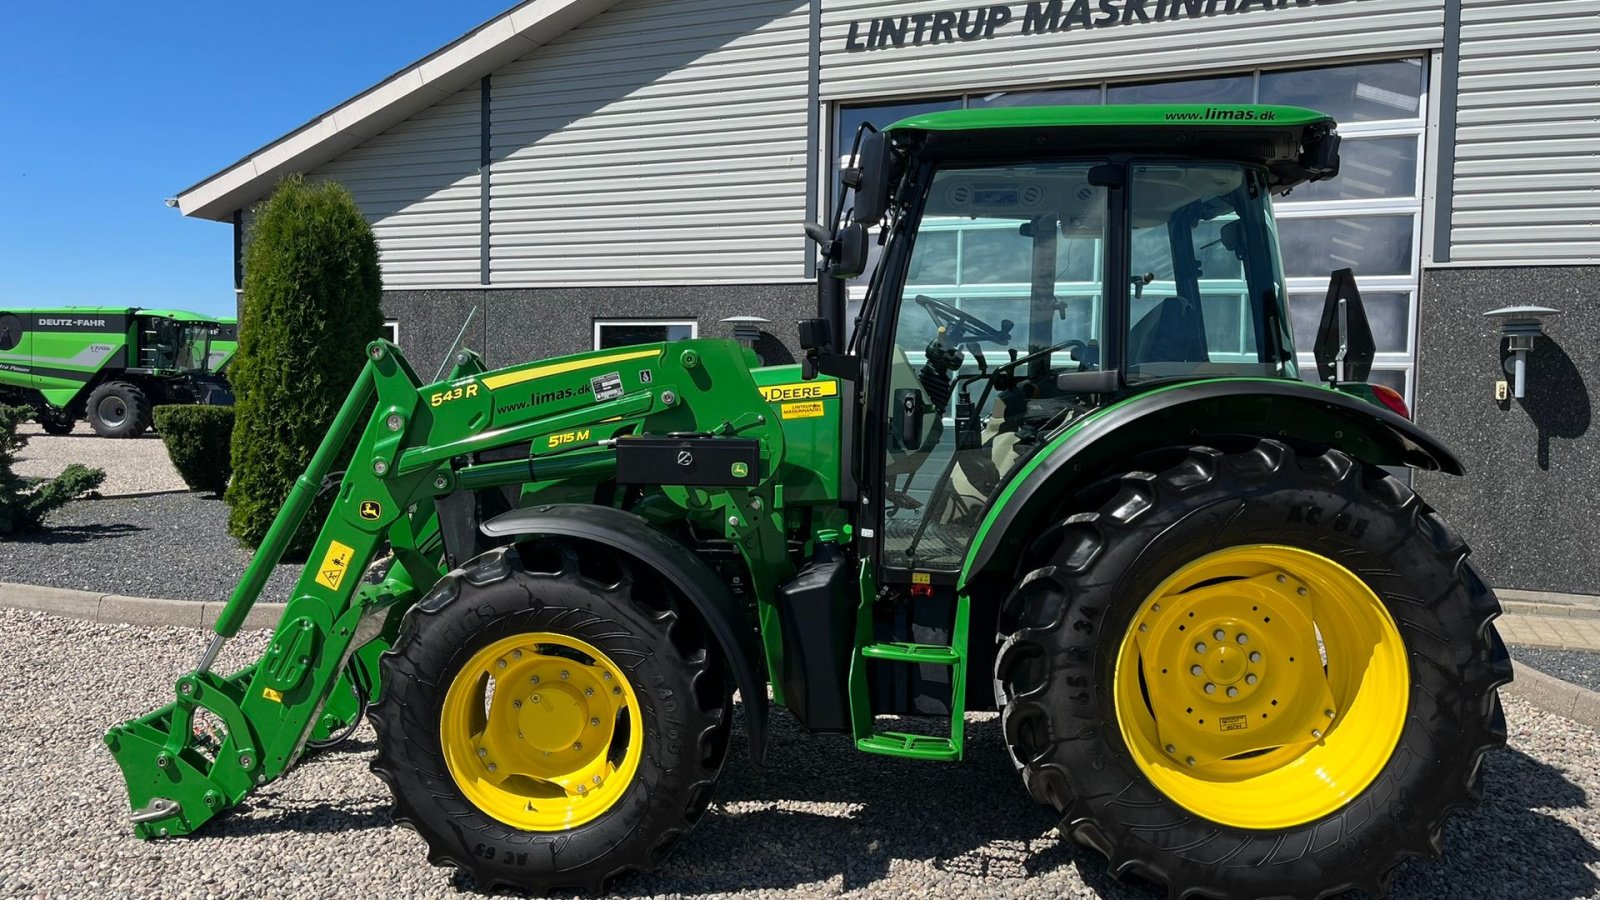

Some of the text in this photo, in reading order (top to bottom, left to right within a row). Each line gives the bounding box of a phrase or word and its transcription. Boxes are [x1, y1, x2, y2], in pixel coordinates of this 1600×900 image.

[845, 0, 1320, 51] LINTRUP MASKINH
[1165, 108, 1276, 121] www.limas.dk
[38, 318, 105, 327] DEUTZ-FAHR
[430, 383, 479, 407] 543 R
[496, 384, 591, 415] www.limas.dk
[770, 386, 822, 400] DEERE
[547, 429, 590, 448] 5115 M
[1286, 505, 1370, 537] AC 65
[504, 851, 528, 866] AC
